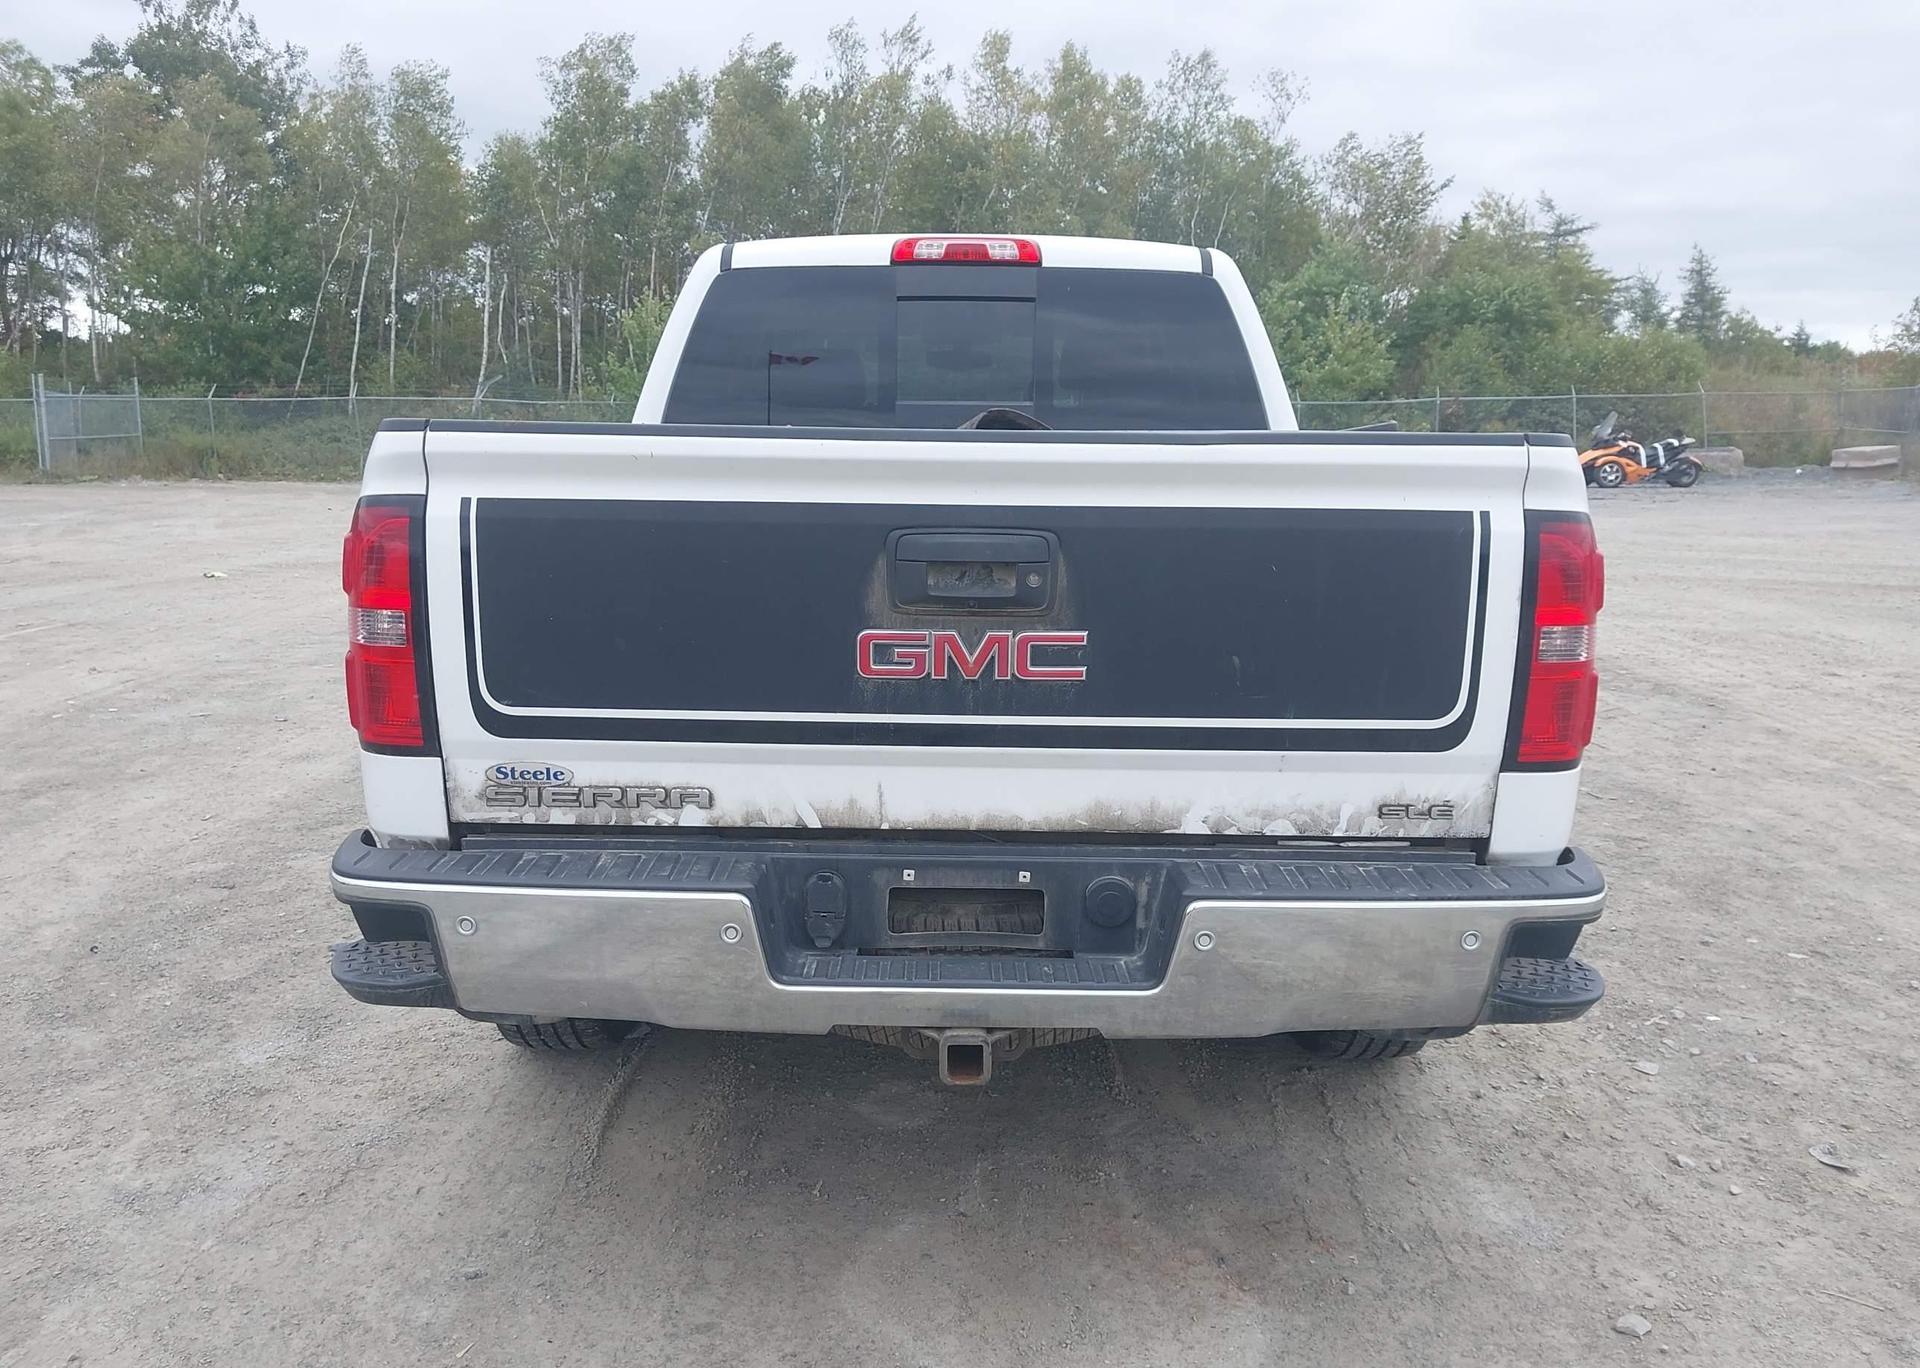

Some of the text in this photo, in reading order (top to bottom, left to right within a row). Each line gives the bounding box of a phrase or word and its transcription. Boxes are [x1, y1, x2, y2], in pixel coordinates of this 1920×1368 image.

[857, 629, 1088, 680] GMC
[495, 766, 565, 781] Steele
[485, 786, 712, 808] SIERRA
[1379, 803, 1454, 820] SLE
